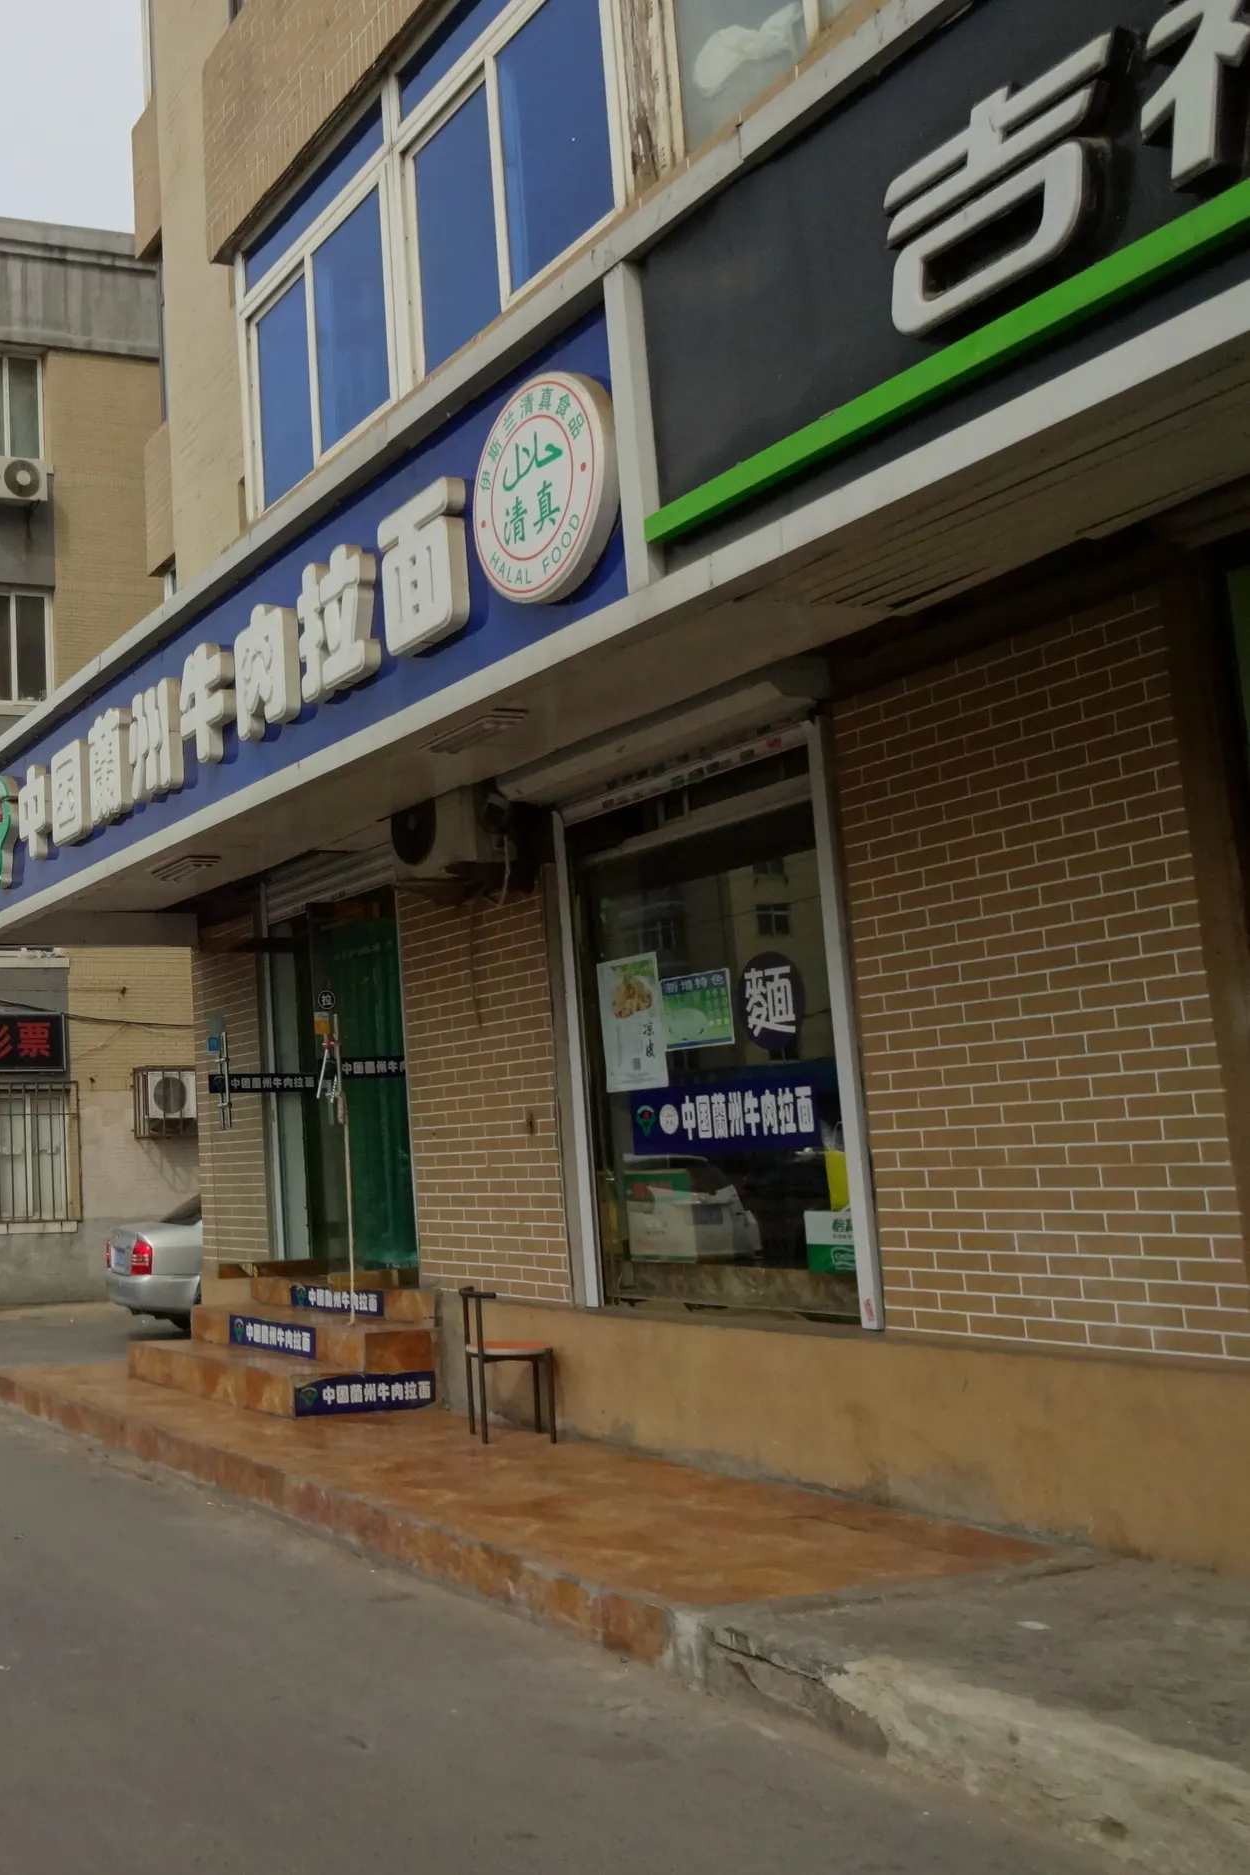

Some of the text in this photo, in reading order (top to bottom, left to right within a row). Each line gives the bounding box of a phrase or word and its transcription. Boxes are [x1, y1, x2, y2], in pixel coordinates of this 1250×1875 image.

[480, 387, 586, 492] 伊斯兰清真食品
[503, 480, 561, 546] 清真
[490, 513, 581, 585] HALAL FOOD
[321, 994, 334, 1006] 拉
